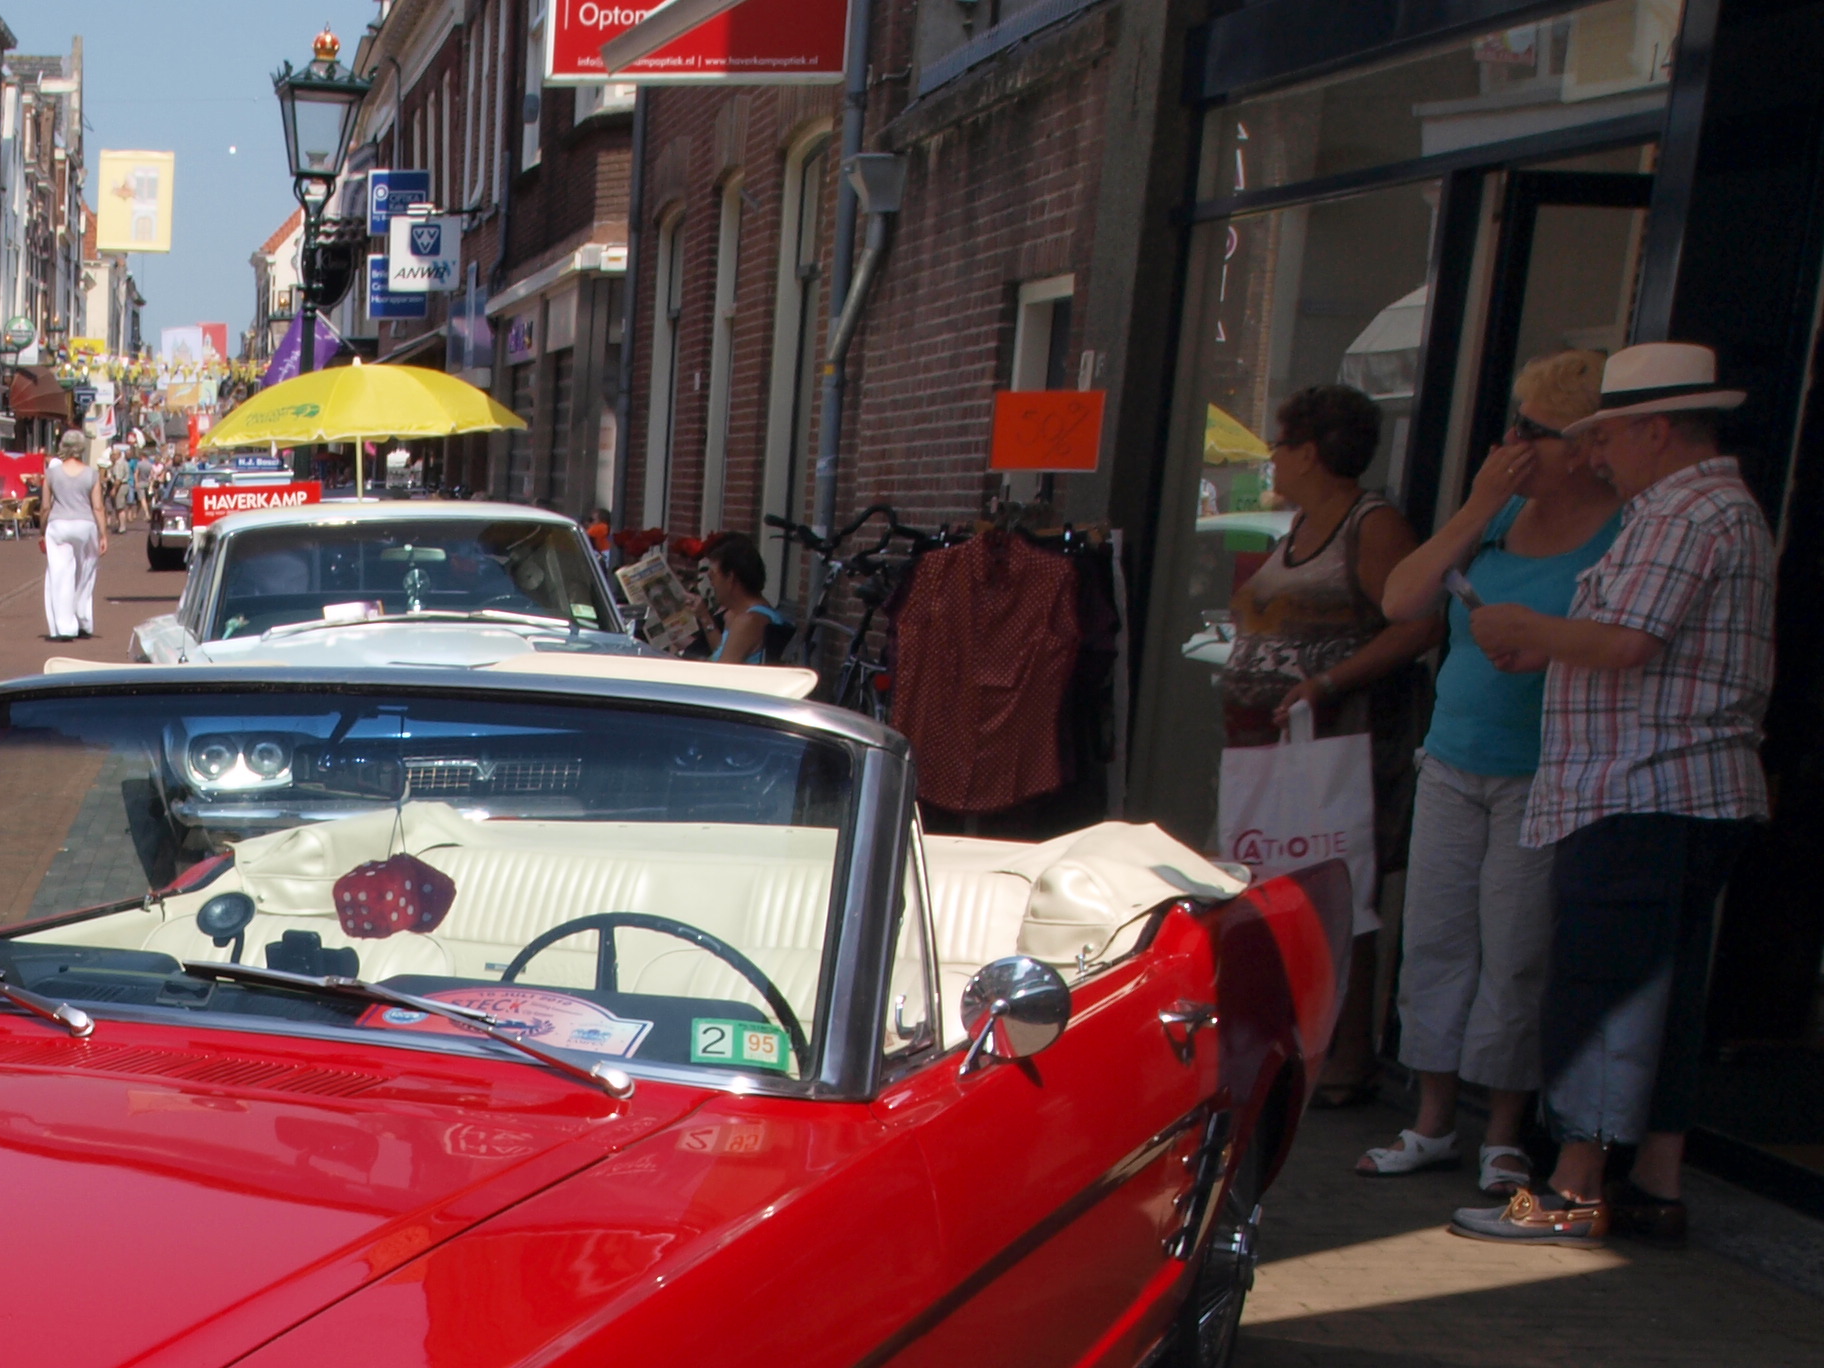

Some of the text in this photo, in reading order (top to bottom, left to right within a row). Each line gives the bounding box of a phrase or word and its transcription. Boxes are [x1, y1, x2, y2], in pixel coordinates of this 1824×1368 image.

[394, 266, 446, 280] ANWB
[203, 491, 308, 511] HAVERKAMP
[701, 1026, 726, 1055] 2
[748, 1033, 774, 1054] 95
